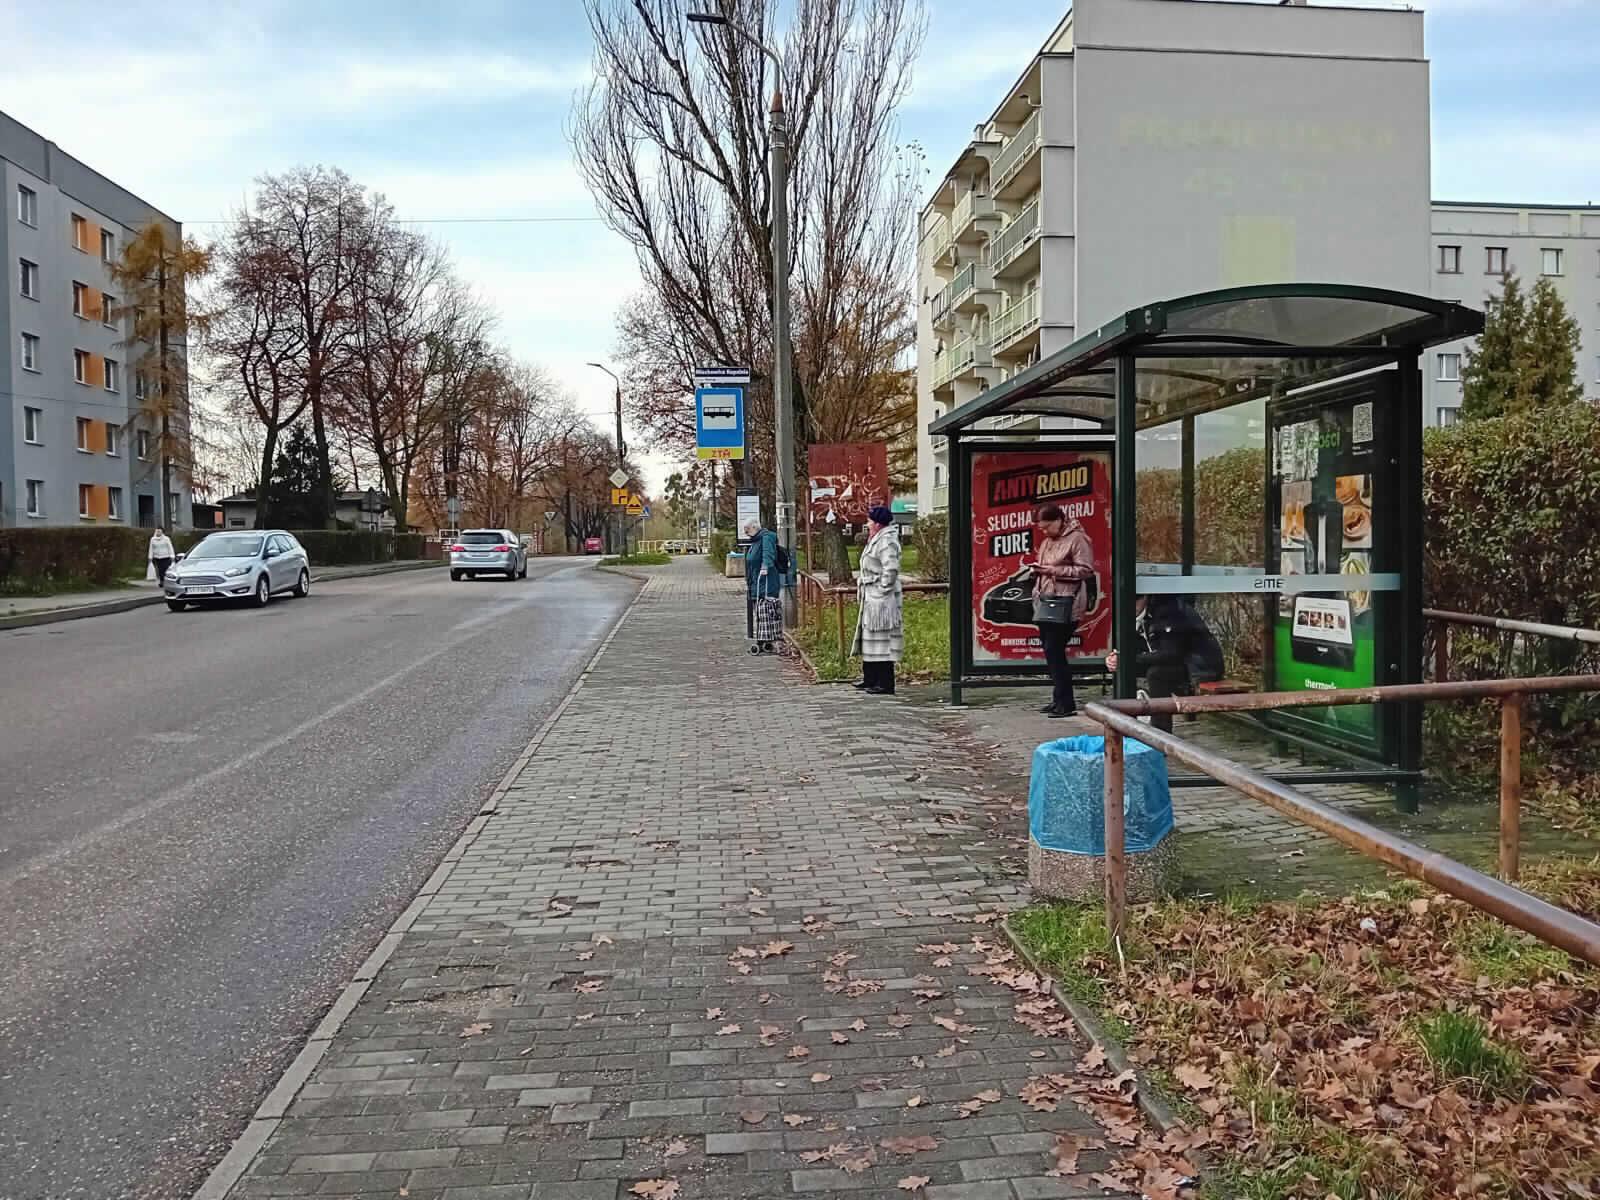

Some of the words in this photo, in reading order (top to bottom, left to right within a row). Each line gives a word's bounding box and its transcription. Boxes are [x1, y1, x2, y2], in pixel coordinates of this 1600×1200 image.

[993, 466, 1088, 502] ANTYRADIO
[1059, 500, 1095, 519] YGRAJ
[993, 531, 1030, 556] FURĘ
